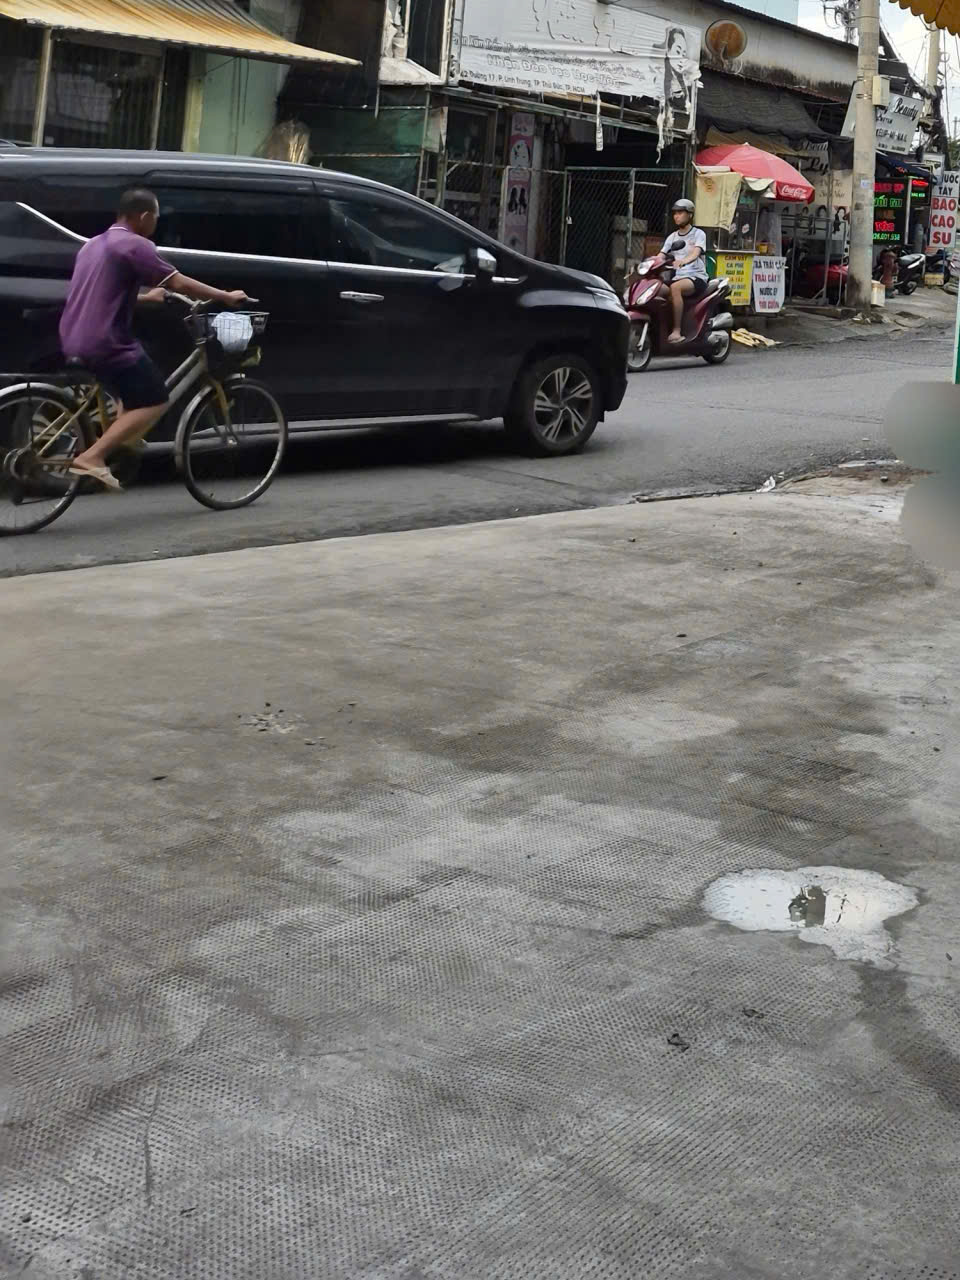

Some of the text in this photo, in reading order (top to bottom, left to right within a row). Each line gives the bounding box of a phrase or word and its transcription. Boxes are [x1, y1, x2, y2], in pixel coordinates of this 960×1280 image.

[931, 197, 957, 211] BAO
[931, 214, 955, 229] CAO
[932, 231, 952, 245] SU
